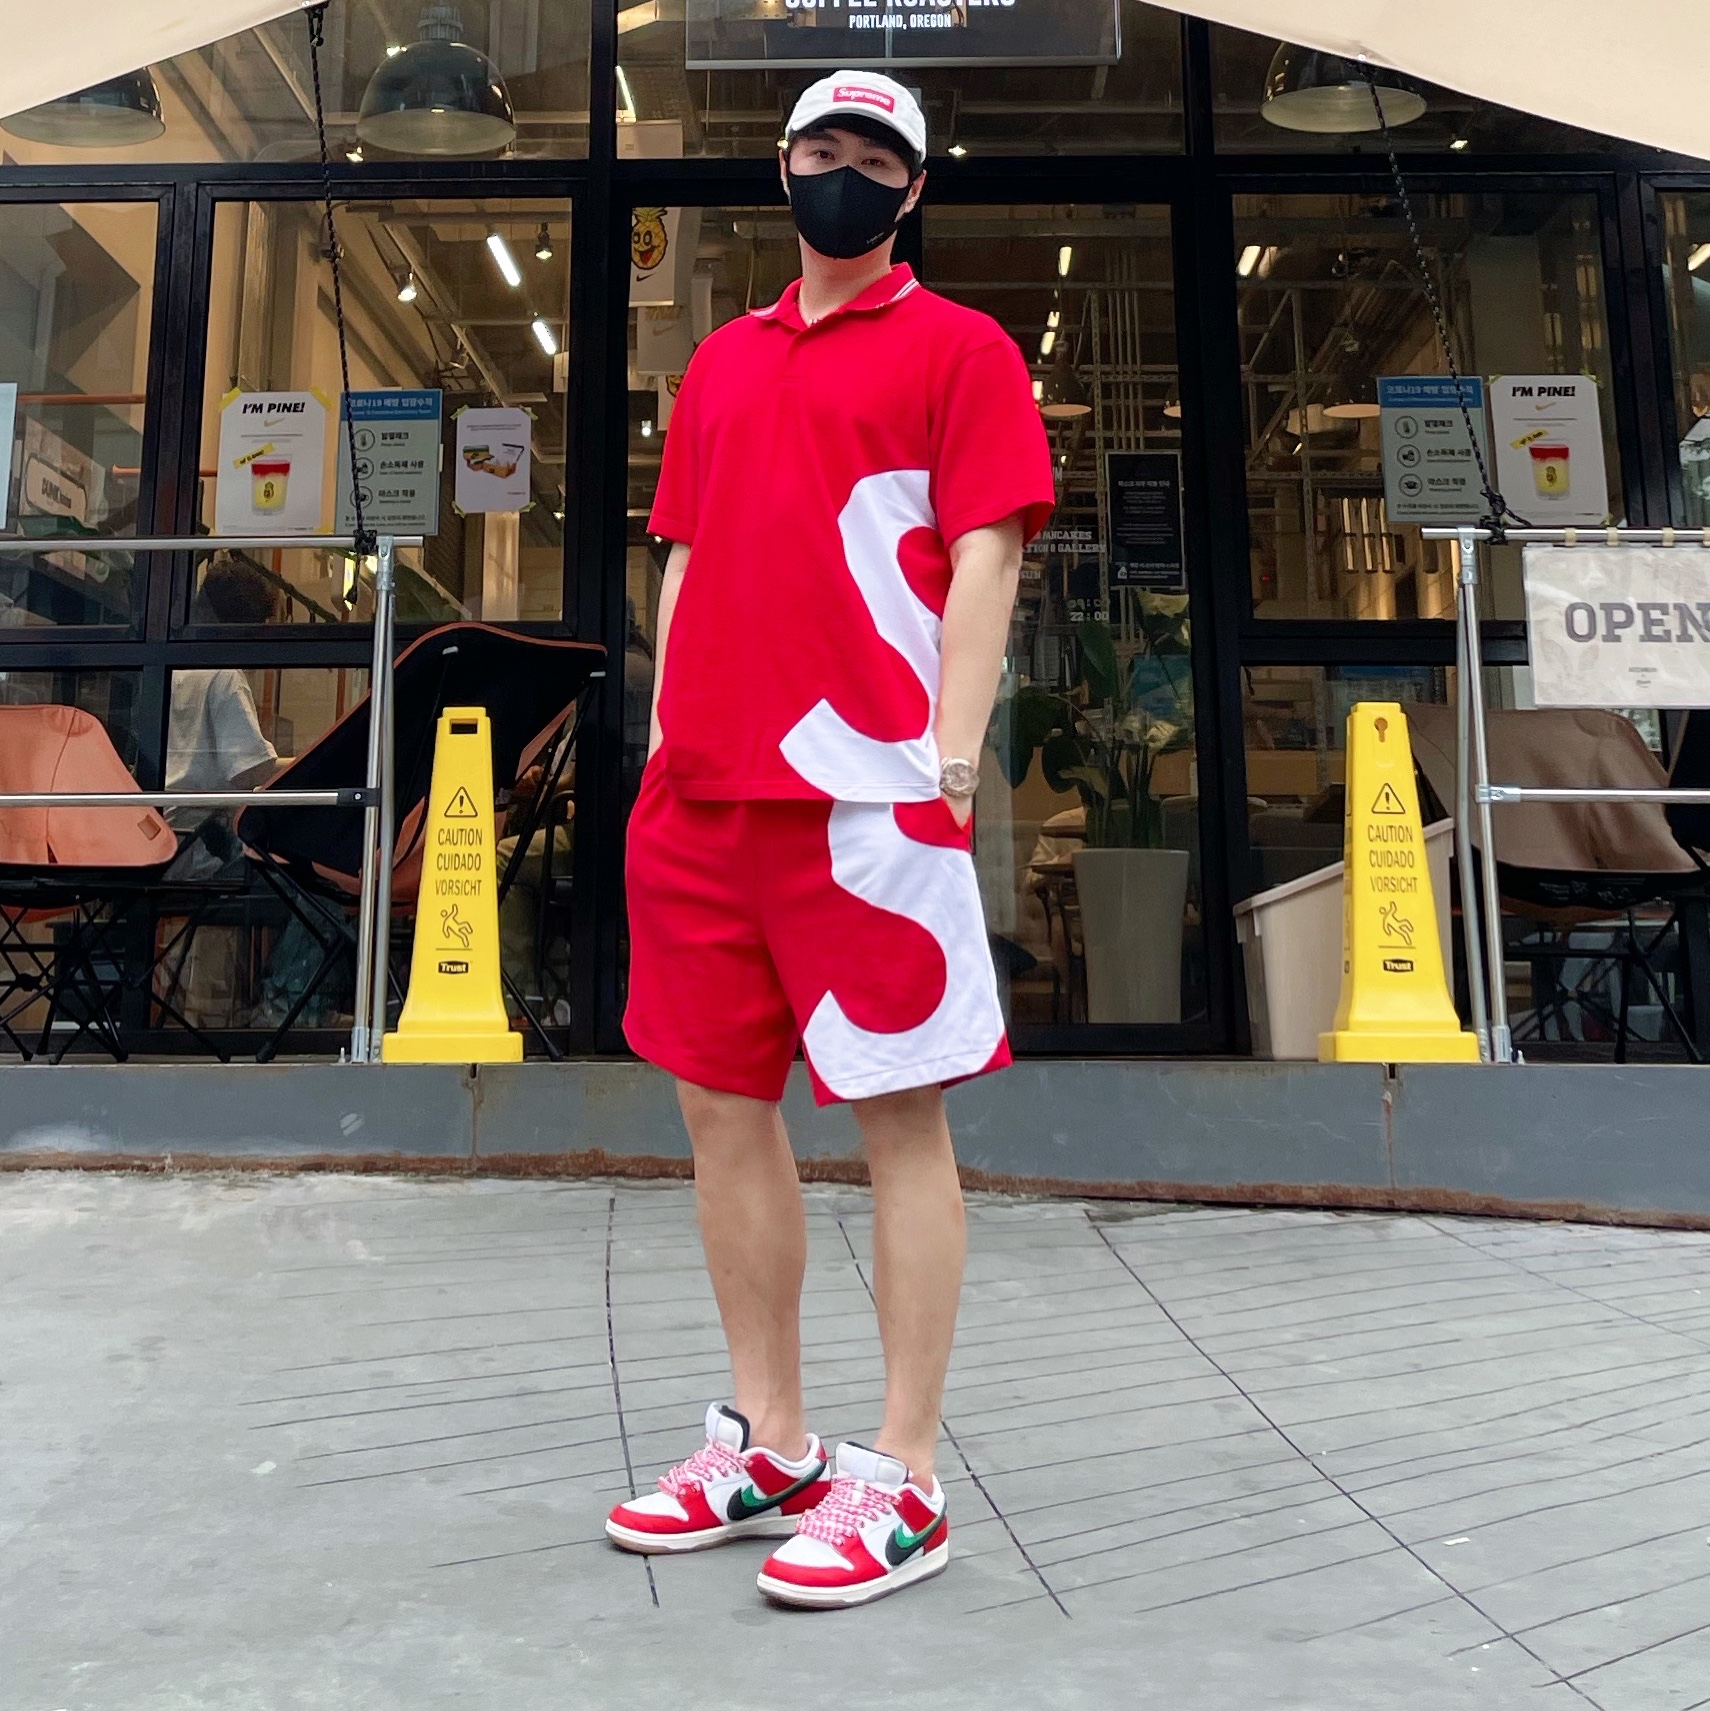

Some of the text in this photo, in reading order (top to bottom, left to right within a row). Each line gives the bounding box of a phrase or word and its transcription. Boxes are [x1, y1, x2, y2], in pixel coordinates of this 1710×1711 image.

[849, 13, 952, 30] PORTLAND, OREGON
[837, 87, 891, 106] Supreme
[1511, 386, 1576, 397] I'M PINE!
[242, 402, 305, 414] I'M PINE!
[1565, 602, 1710, 643] OPEN
[437, 828, 483, 846] CAUTION
[1367, 824, 1413, 843] CAUTION
[436, 853, 481, 872] CUIDADO
[1369, 850, 1415, 869] CUIDADO
[435, 879, 482, 896] VORSICHT
[1370, 876, 1418, 894] VORSICHT
[440, 962, 467, 973] Trust
[1385, 960, 1412, 972] Trust
